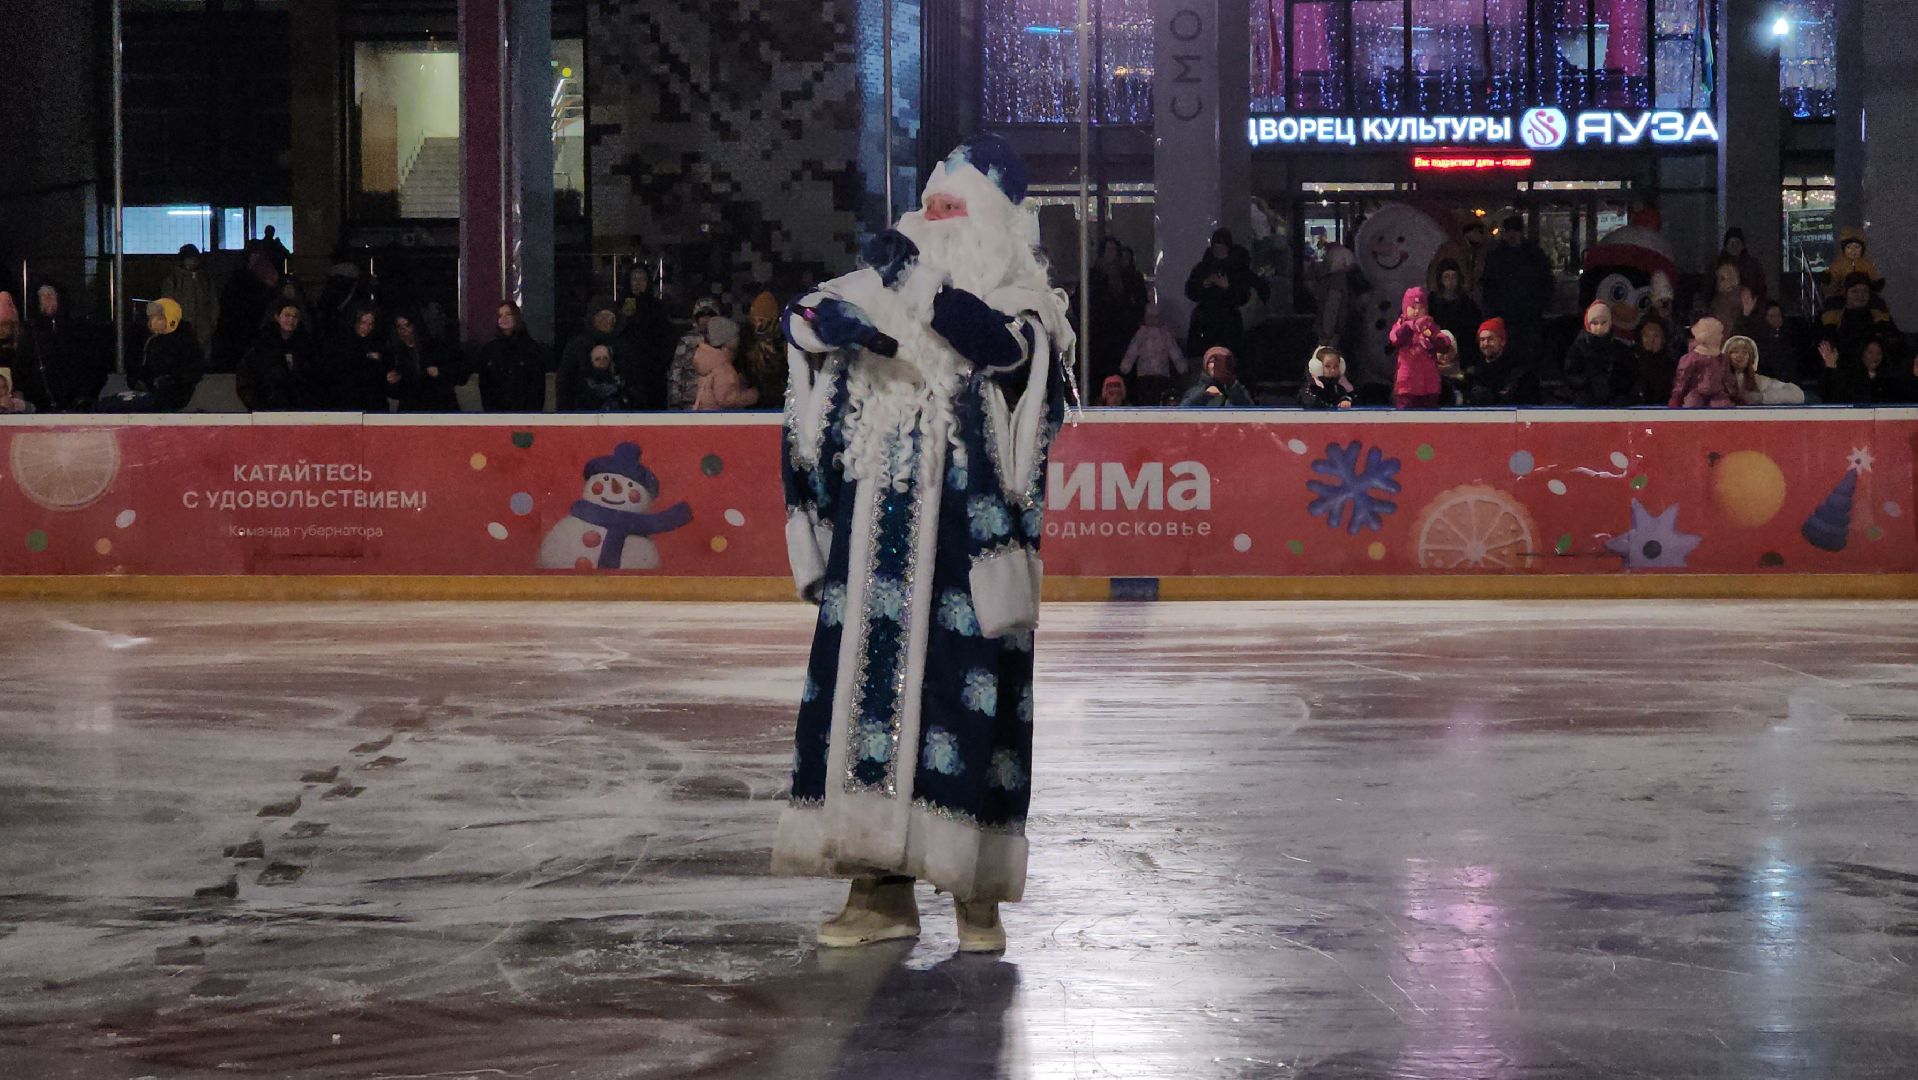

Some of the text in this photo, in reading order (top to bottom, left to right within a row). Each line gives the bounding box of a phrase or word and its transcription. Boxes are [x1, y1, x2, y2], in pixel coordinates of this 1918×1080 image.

[1362, 117, 1511, 142] КУЛЬТУРЫ
[1576, 111, 1719, 143] ЯУЗА
[233, 459, 372, 482] КАТАЙТЕСЬ
[182, 490, 427, 511] С УДОВОЛЬСТВИЕМ!
[228, 525, 383, 540] Команда губернатора
